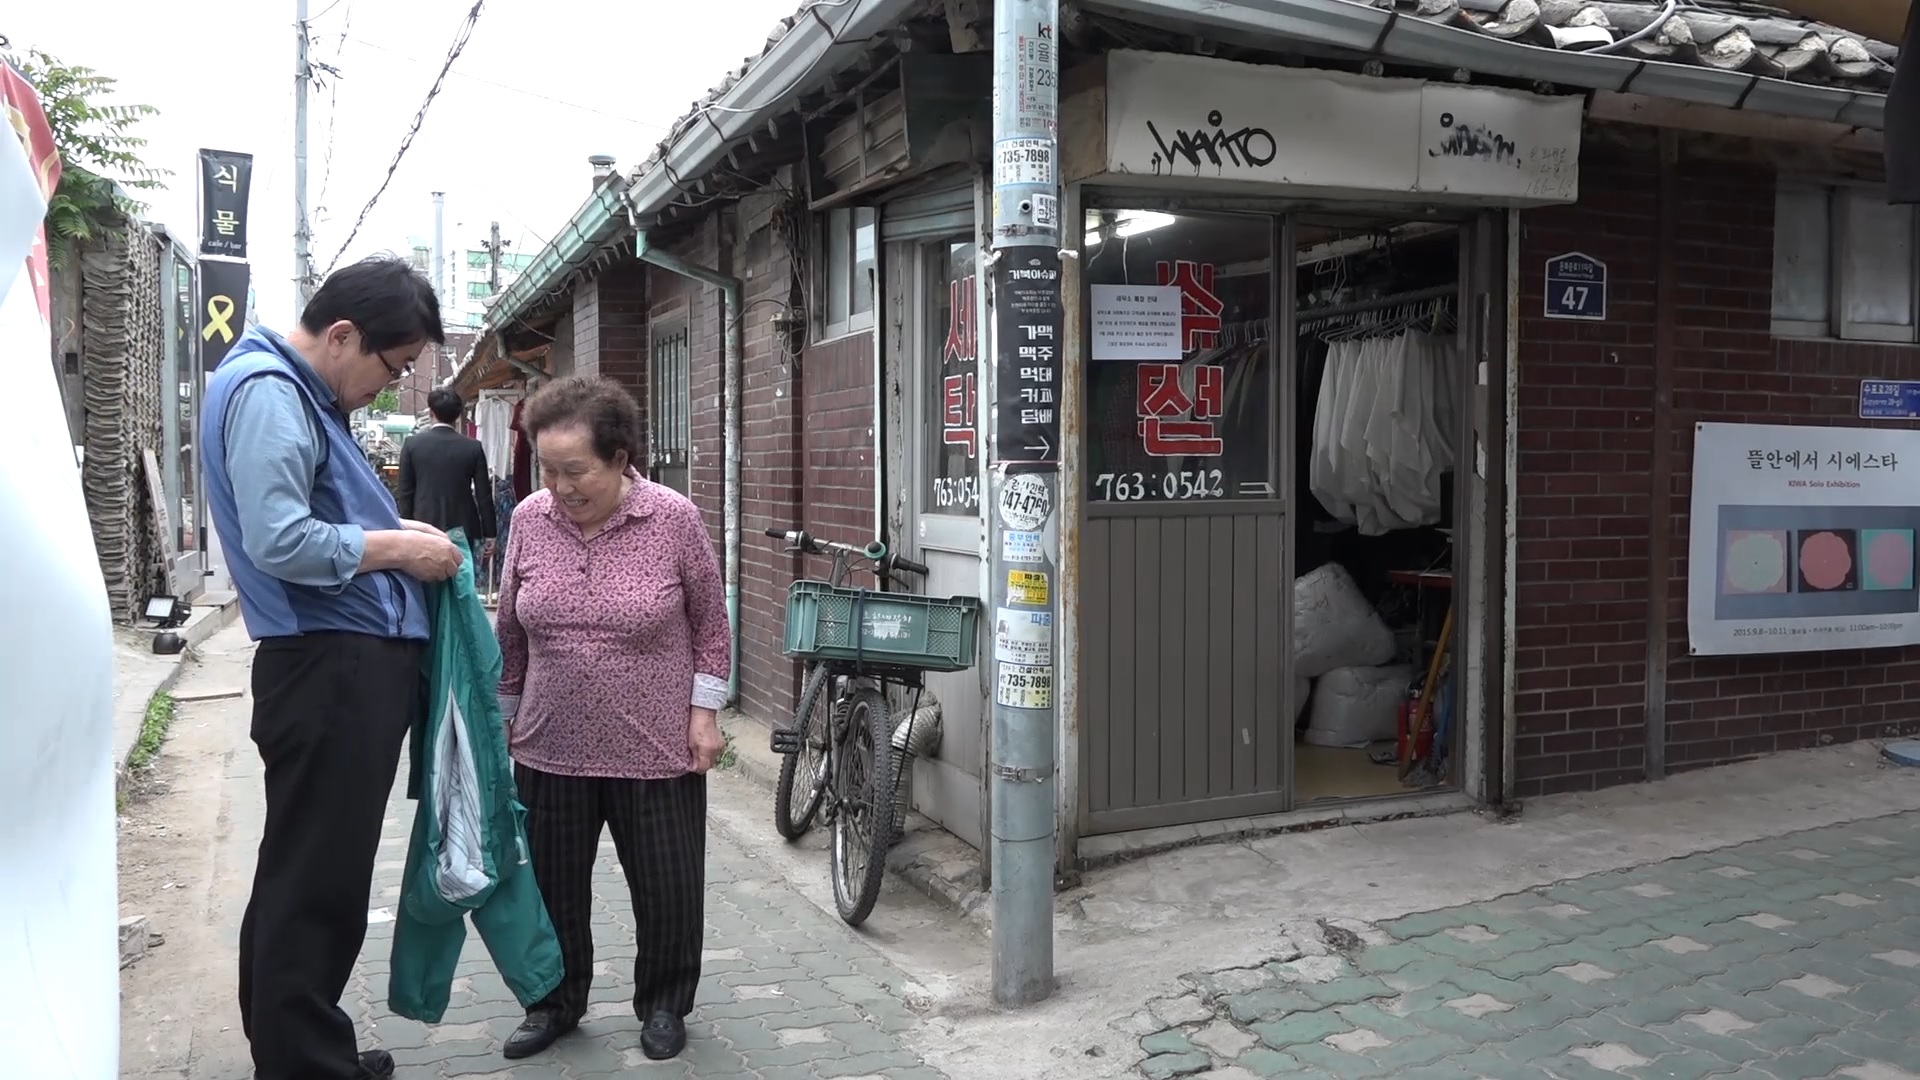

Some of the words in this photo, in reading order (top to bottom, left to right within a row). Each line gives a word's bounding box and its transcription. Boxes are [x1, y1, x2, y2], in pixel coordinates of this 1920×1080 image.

[1038, 22, 1052, 39] kt
[1003, 149, 1050, 164] 735-7898
[212, 164, 240, 236] 식물
[1561, 286, 1588, 310] 47
[1018, 325, 1053, 340] 가맥
[1019, 346, 1053, 361] 맥주
[944, 274, 976, 459] 세탁
[1020, 367, 1053, 382] 먹태
[1021, 388, 1053, 403] 커피
[1021, 409, 1053, 424] 담배
[1748, 449, 1818, 471] 뜰안에서
[1827, 451, 1899, 472] 시에스타
[1095, 469, 1224, 501] 763:0542
[1788, 480, 1807, 488] KIWA
[1826, 480, 1861, 488] Exhibition
[1019, 666, 1044, 674] 건설인력
[1008, 674, 1051, 689] 735-7898
